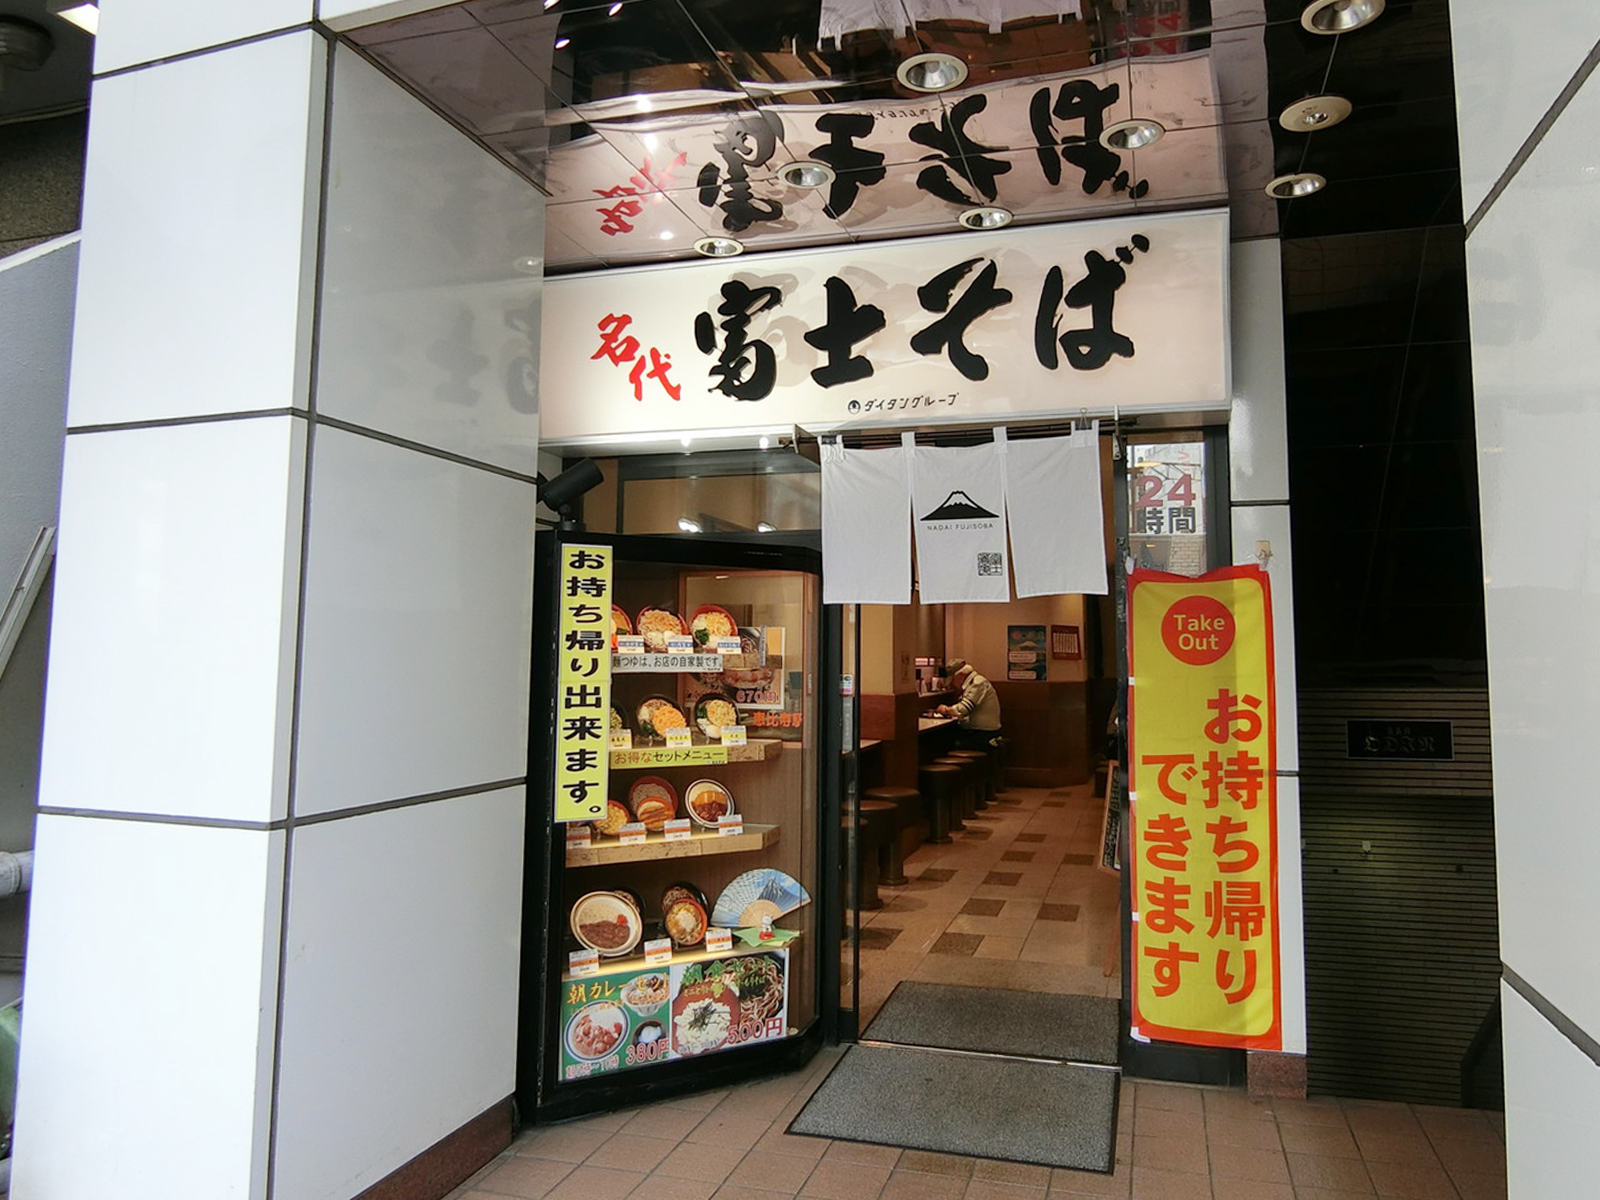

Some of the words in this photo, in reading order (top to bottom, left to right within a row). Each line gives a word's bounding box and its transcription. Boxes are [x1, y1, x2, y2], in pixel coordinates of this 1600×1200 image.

[695, 234, 1150, 402] 富士そば
[591, 313, 682, 402] 名代
[864, 392, 960, 412] ダイタングループ
[1136, 474, 1197, 508] 24
[1137, 507, 1196, 534] 時間
[1173, 614, 1226, 631] Take
[1178, 633, 1220, 651] Out
[562, 549, 607, 814] お持ち帰り出来ます。
[614, 750, 725, 765] お得なセットメニュー
[1202, 688, 1266, 1005] お持ち帰り
[1142, 753, 1200, 998] できます
[567, 971, 671, 1005] 朝カレーセット
[726, 1017, 783, 1045] 500円
